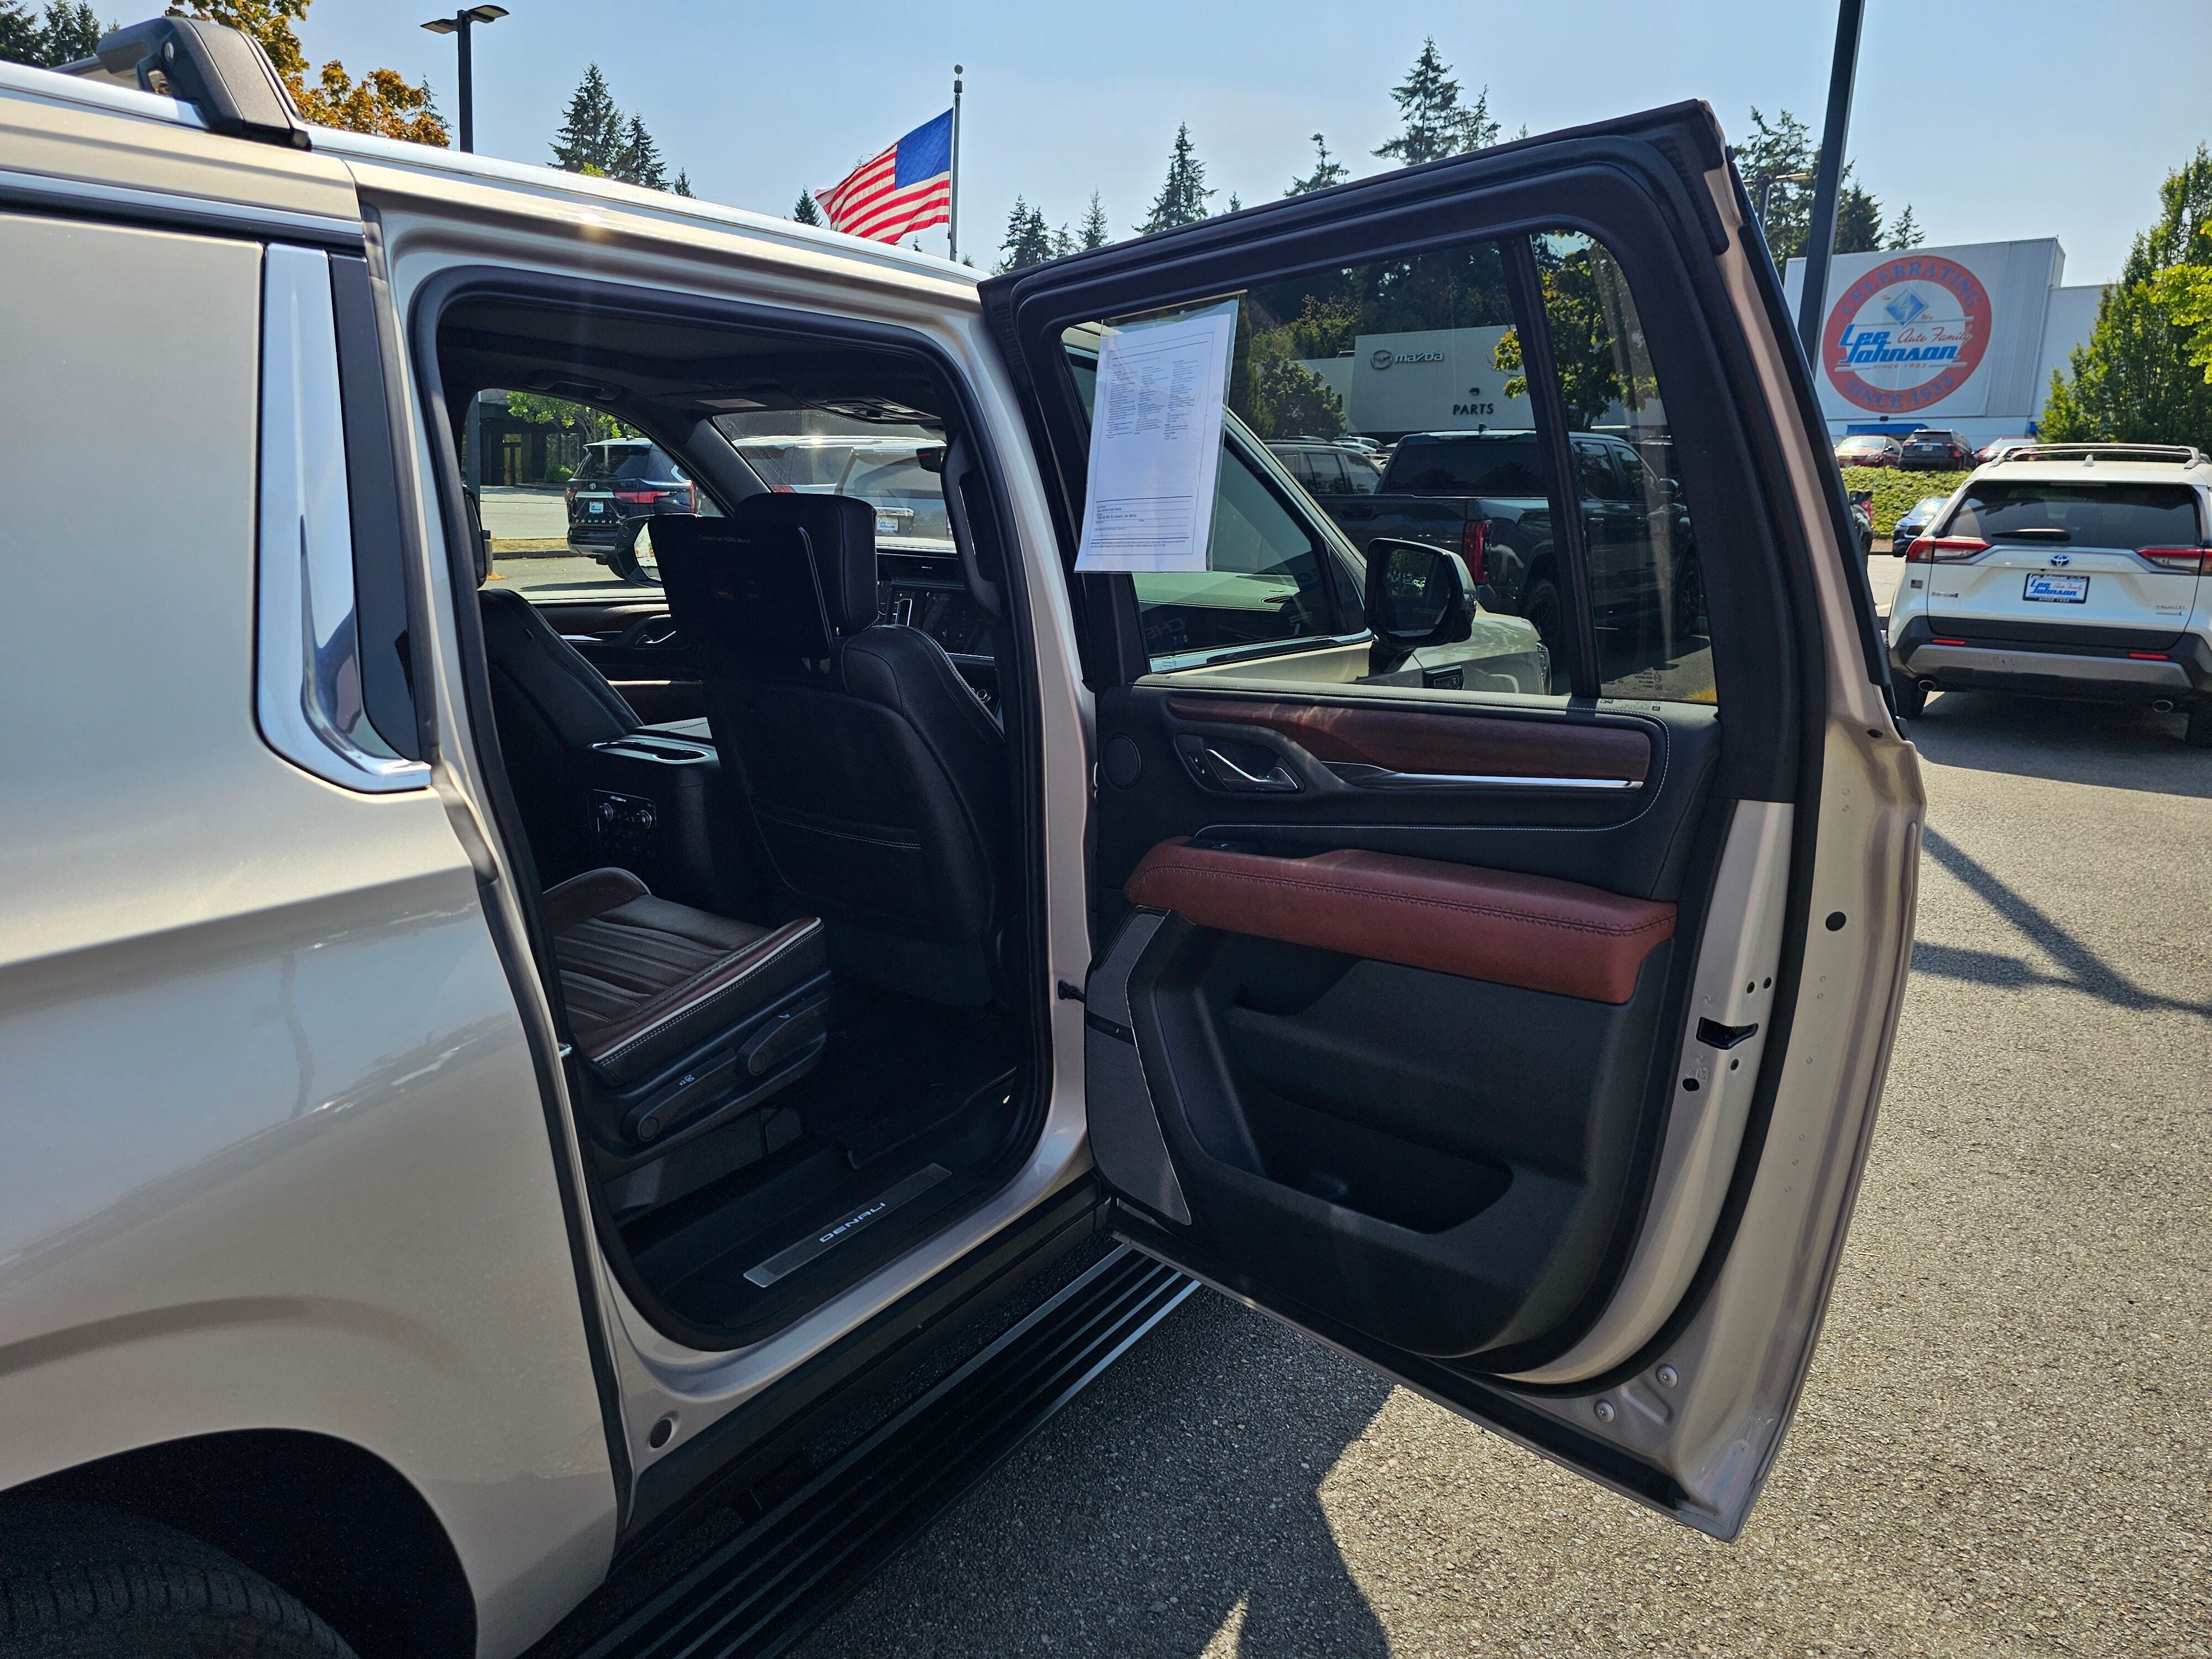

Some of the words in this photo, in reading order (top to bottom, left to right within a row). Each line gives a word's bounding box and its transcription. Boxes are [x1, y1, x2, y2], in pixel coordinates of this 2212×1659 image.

[1841, 261, 1982, 315] CELEBRATING
[1839, 324, 1891, 346] Lee
[1897, 328, 1927, 344] Auto
[1931, 325, 1973, 348] Family
[1839, 341, 1960, 364] Johnson
[1844, 378, 1903, 409] SINCE
[1911, 374, 1954, 405] 1933
[1453, 403, 1494, 415] PARTS
[819, 1202, 886, 1243] DENALI
